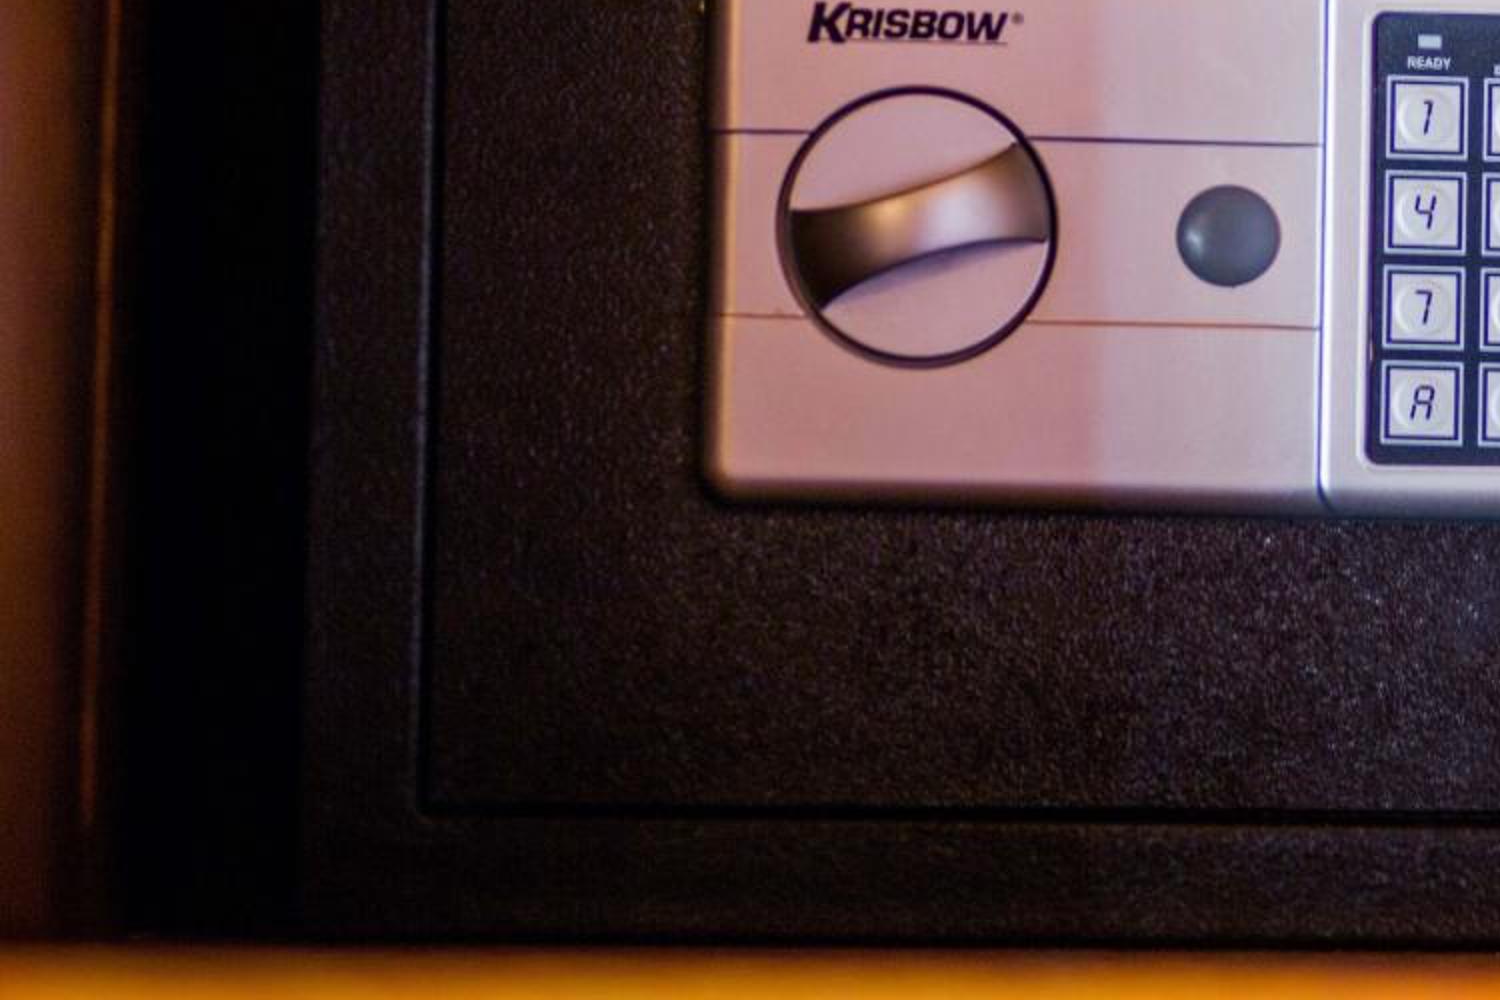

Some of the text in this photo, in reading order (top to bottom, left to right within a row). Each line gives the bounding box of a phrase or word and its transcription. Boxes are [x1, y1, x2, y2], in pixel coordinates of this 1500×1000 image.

[1407, 55, 1452, 71] READY
[1422, 100, 1434, 135] 1
[1414, 195, 1437, 230] 4
[1415, 289, 1434, 325] 7
[1410, 384, 1436, 420] A
